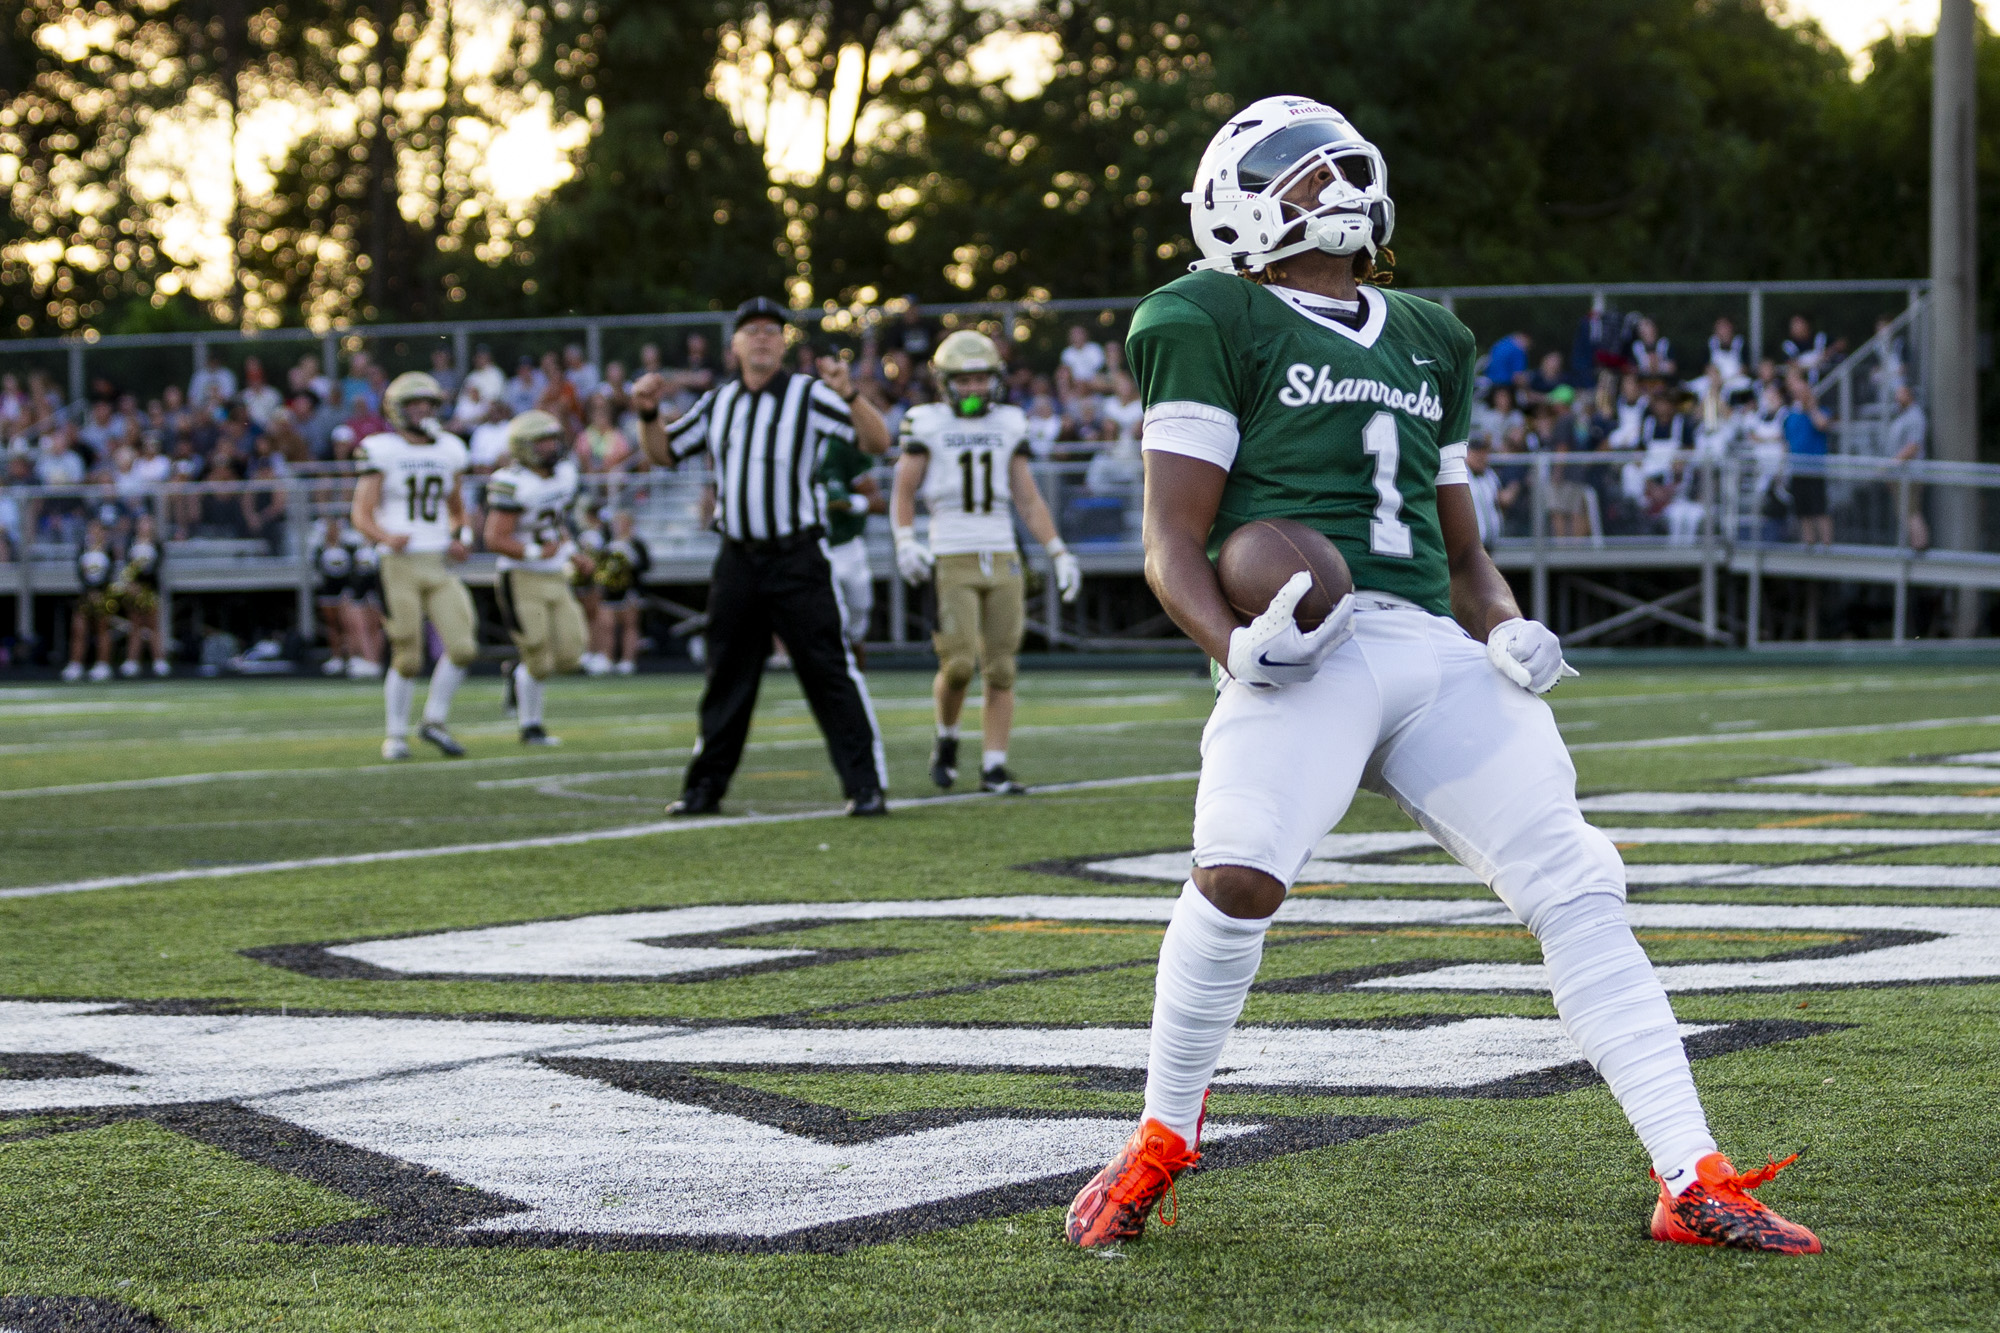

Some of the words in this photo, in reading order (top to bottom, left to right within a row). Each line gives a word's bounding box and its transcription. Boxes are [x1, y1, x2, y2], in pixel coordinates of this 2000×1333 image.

[1278, 363, 1443, 421] Shamrocks
[406, 474, 444, 522] 10
[958, 450, 994, 513] 11
[1361, 410, 1413, 559] 1
